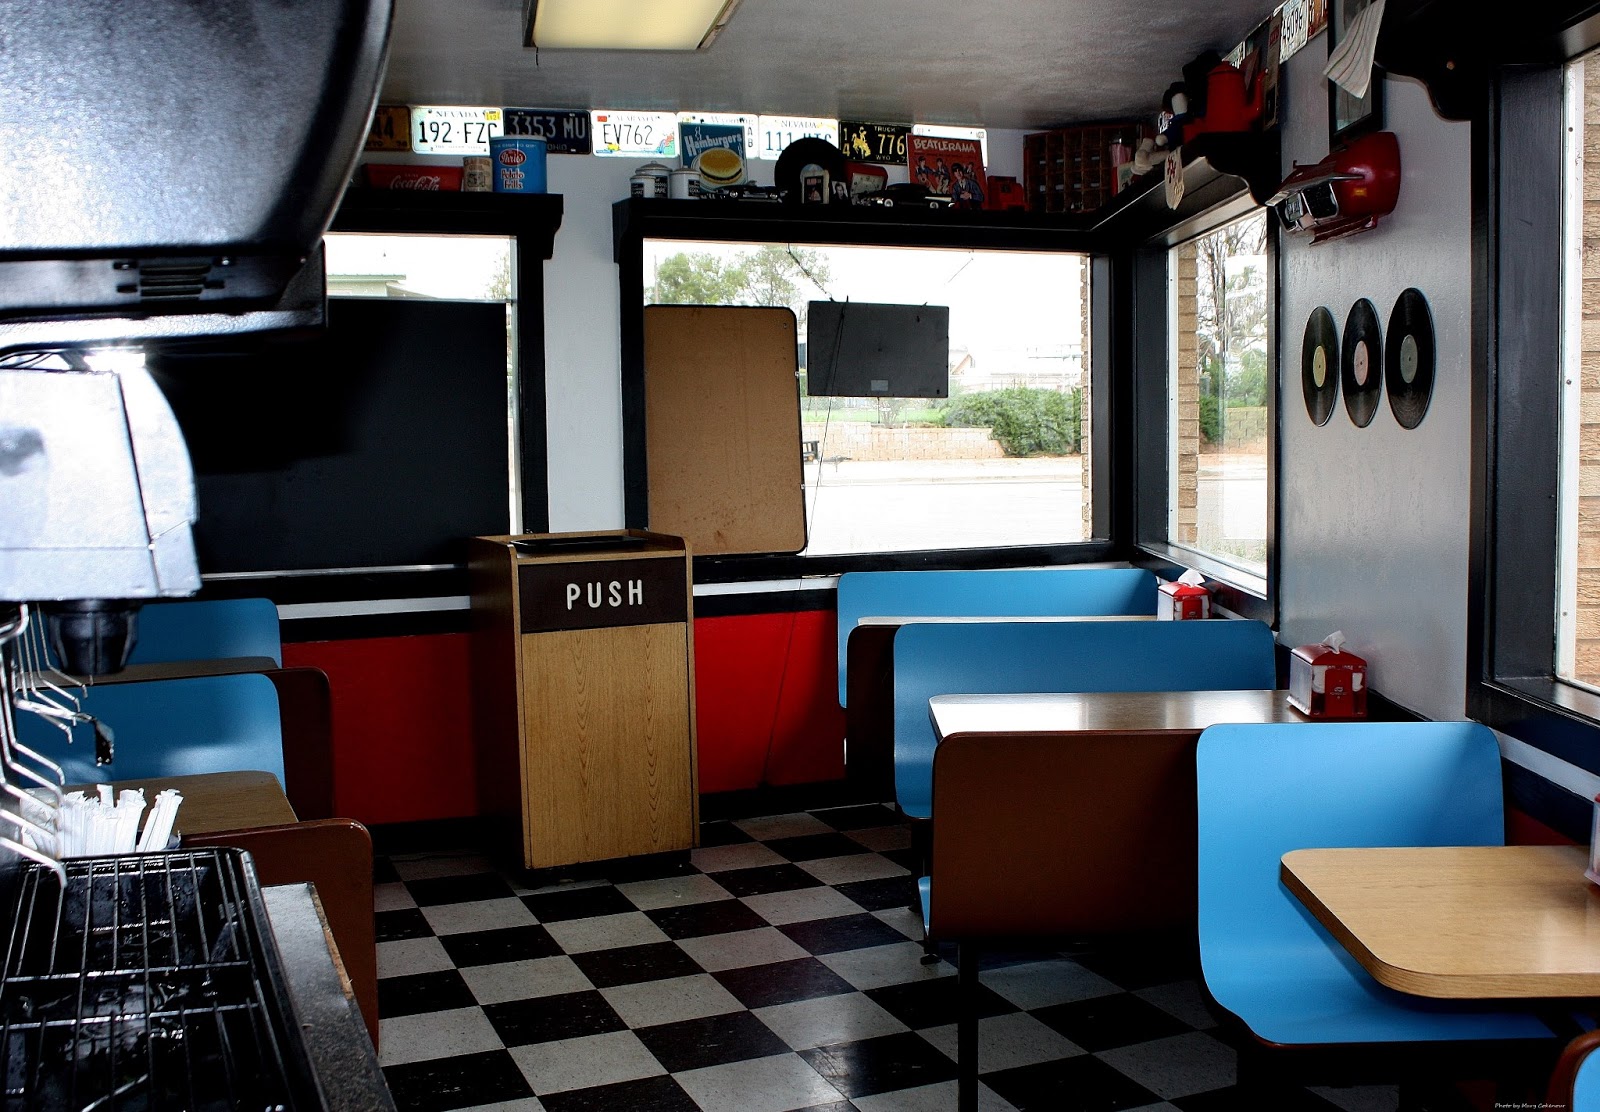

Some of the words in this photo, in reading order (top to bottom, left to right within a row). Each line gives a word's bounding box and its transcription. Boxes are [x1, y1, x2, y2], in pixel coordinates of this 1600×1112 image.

[509, 115, 556, 138] 3353
[563, 117, 586, 139] MU
[603, 124, 653, 145] EV762
[684, 133, 742, 157] Hamburgers
[913, 138, 976, 153] BEATLERAMA
[566, 579, 643, 610] PUSH
